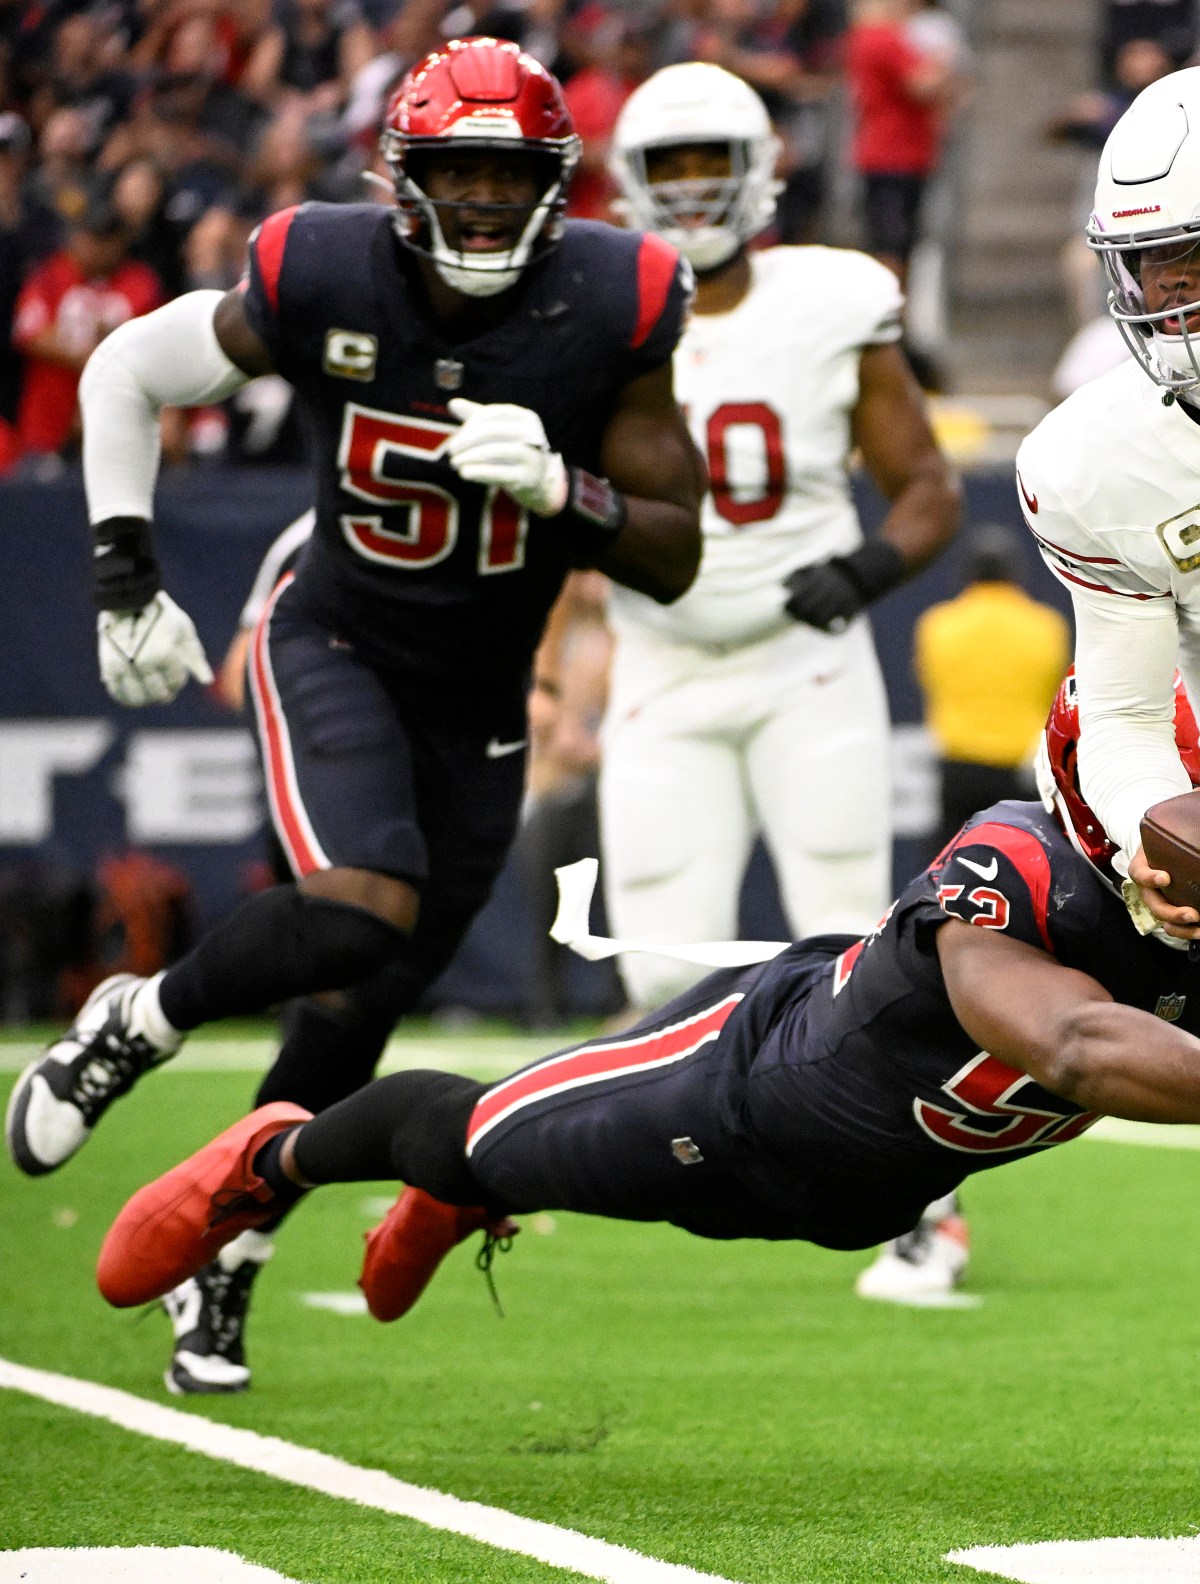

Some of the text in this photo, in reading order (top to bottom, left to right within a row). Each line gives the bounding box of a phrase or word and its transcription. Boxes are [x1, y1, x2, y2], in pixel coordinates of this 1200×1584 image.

[1111, 204, 1162, 219] CARDINALS
[326, 332, 376, 370] C
[337, 401, 530, 577] 51
[684, 401, 787, 527] 0
[912, 1050, 1106, 1154] 5
